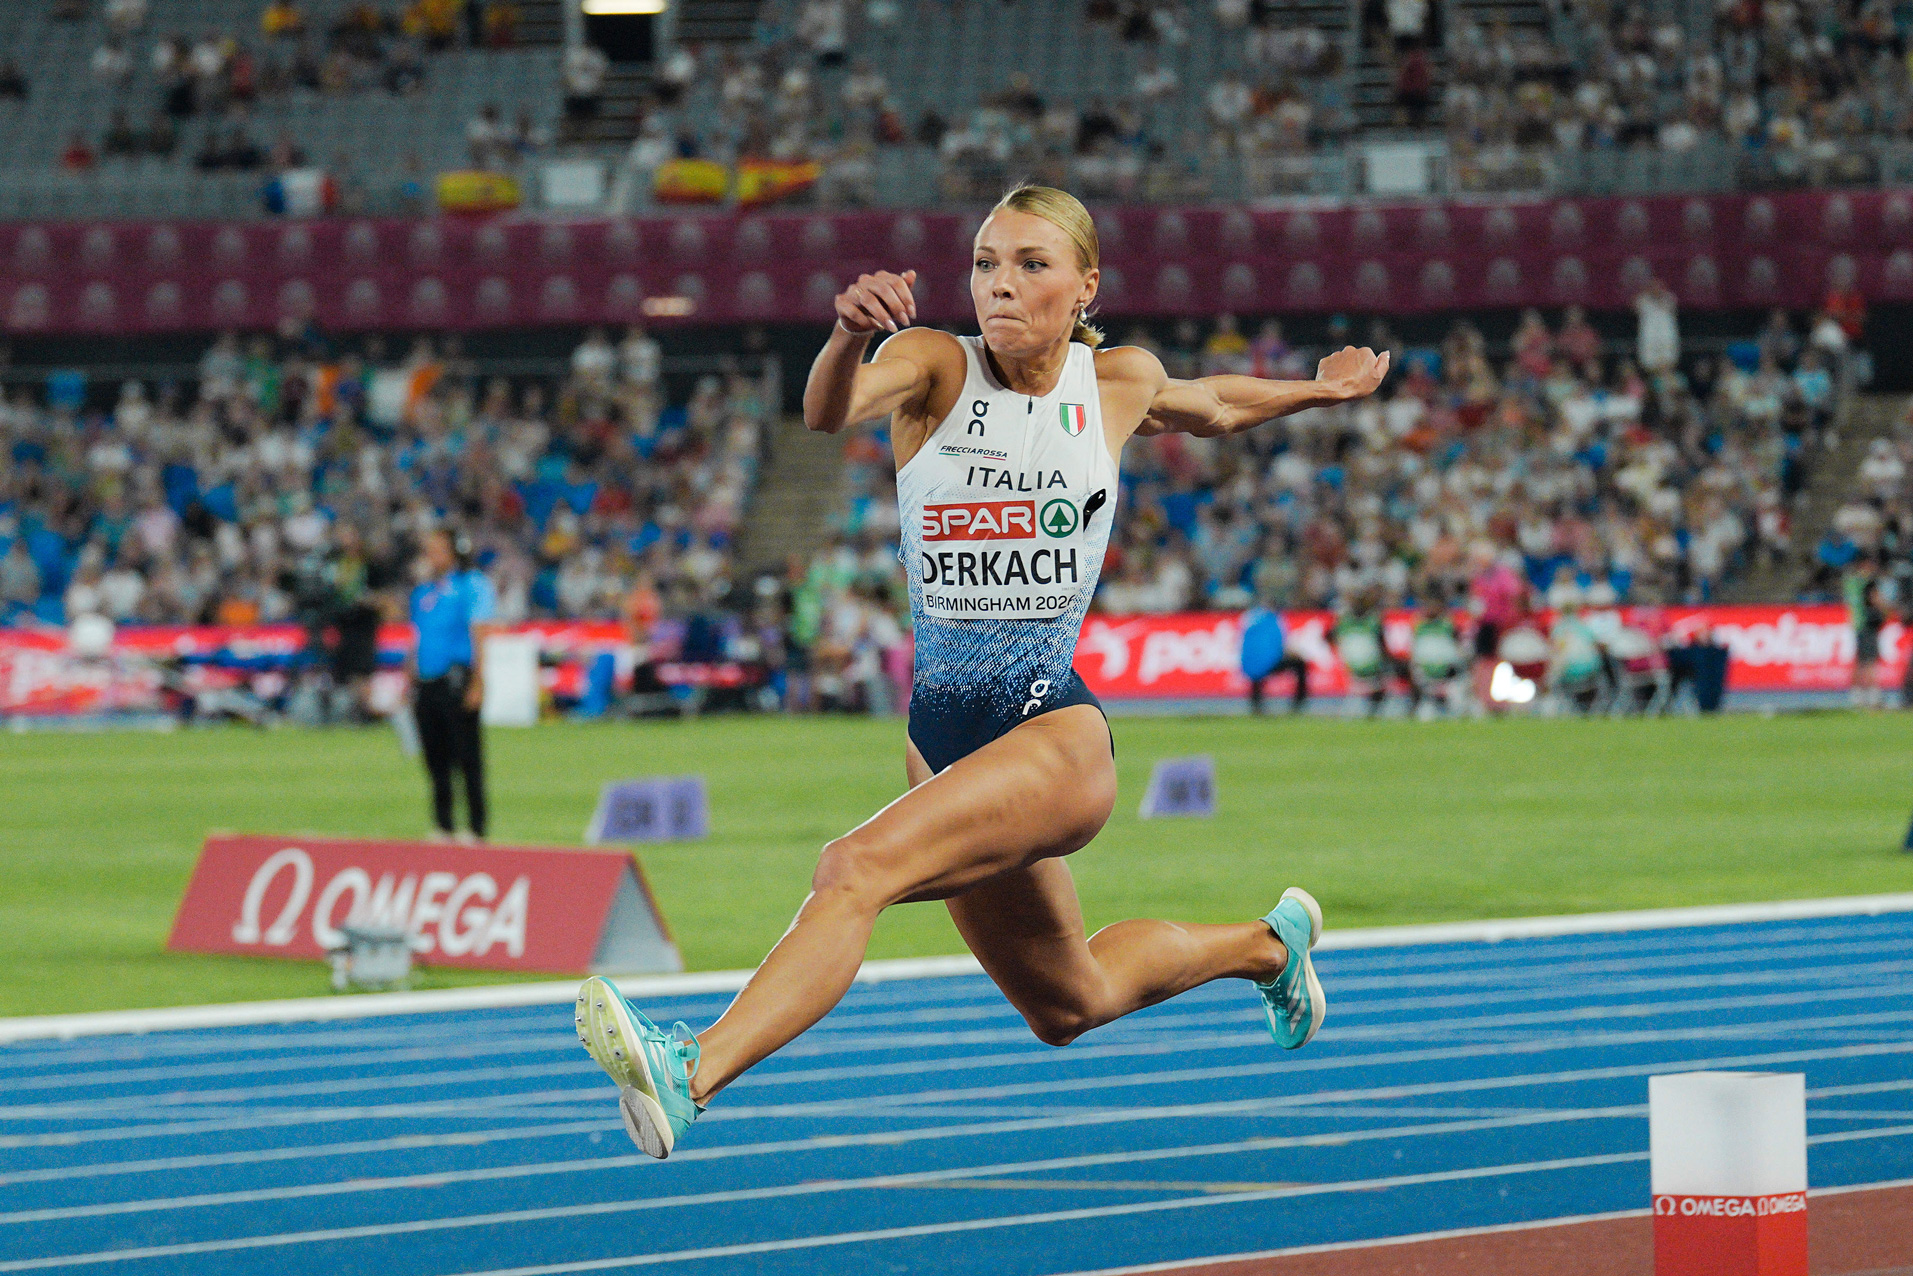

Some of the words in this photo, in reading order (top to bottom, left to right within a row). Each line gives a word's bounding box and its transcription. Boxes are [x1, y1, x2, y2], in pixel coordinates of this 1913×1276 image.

[940, 445, 1008, 458] FRECCIAROSSA
[966, 466, 1068, 492] ITALIA
[922, 506, 1033, 536] SPAR
[922, 548, 1078, 587] DERKACH
[926, 594, 1031, 612] BIRMINGHAM
[312, 866, 531, 959] OMEGA
[1680, 1198, 1757, 1217] OMEGA
[1770, 1194, 1807, 1214] OMEGA
